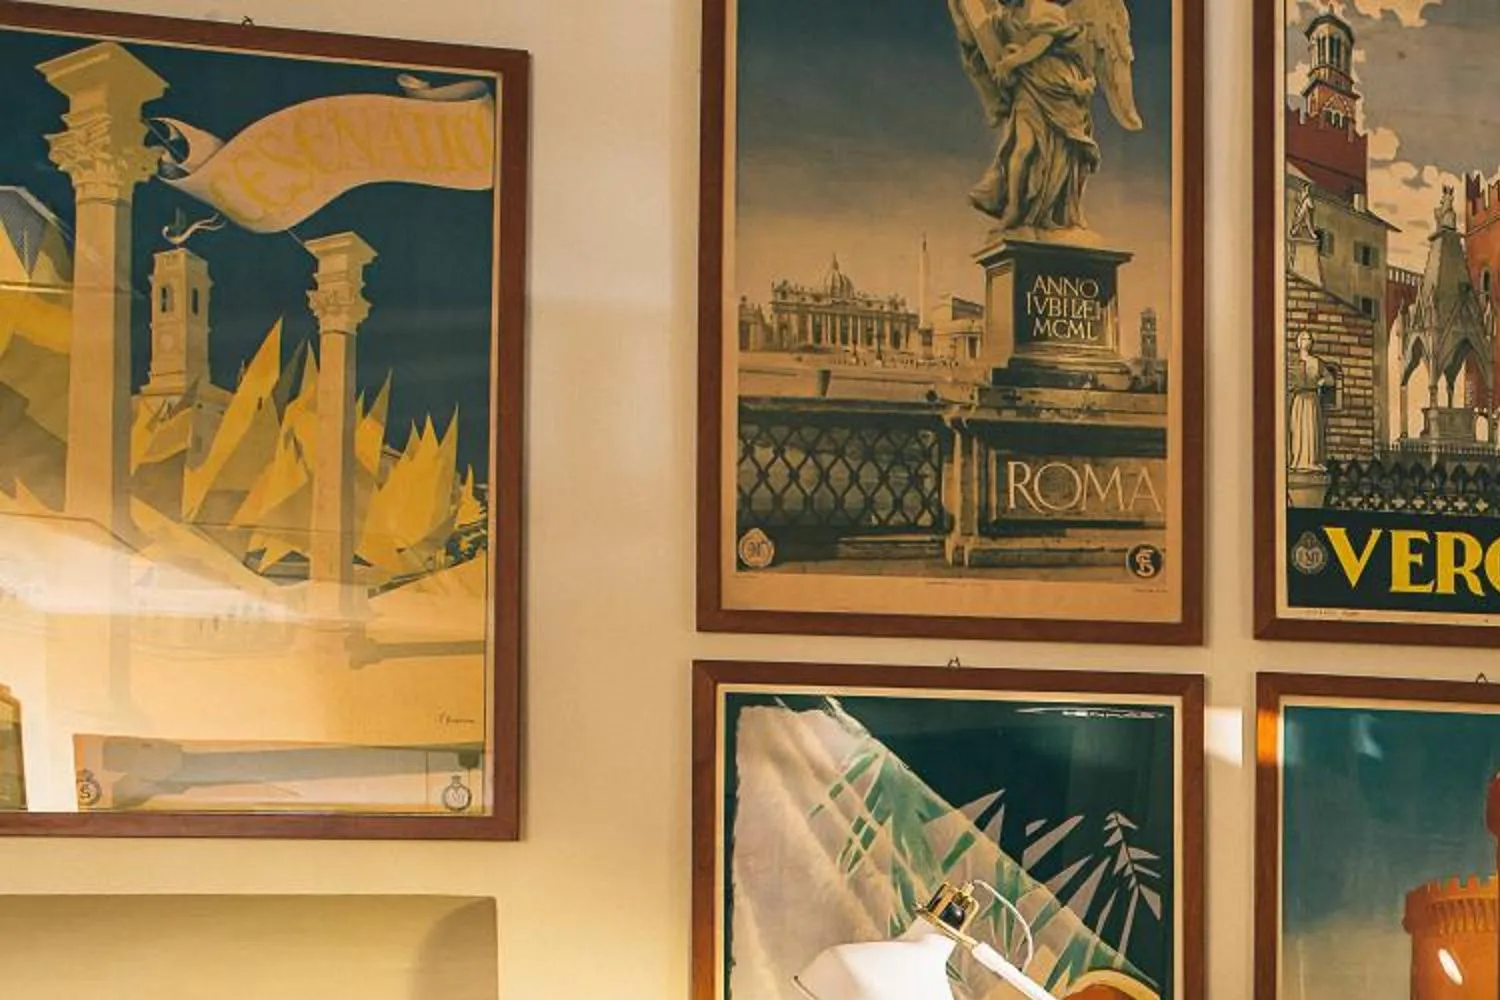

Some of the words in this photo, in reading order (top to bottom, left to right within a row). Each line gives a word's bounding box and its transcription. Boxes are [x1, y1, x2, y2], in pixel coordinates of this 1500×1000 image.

[1032, 274, 1099, 298] ANNO
[1032, 317, 1099, 340] MCML
[1006, 460, 1163, 513] ROMA
